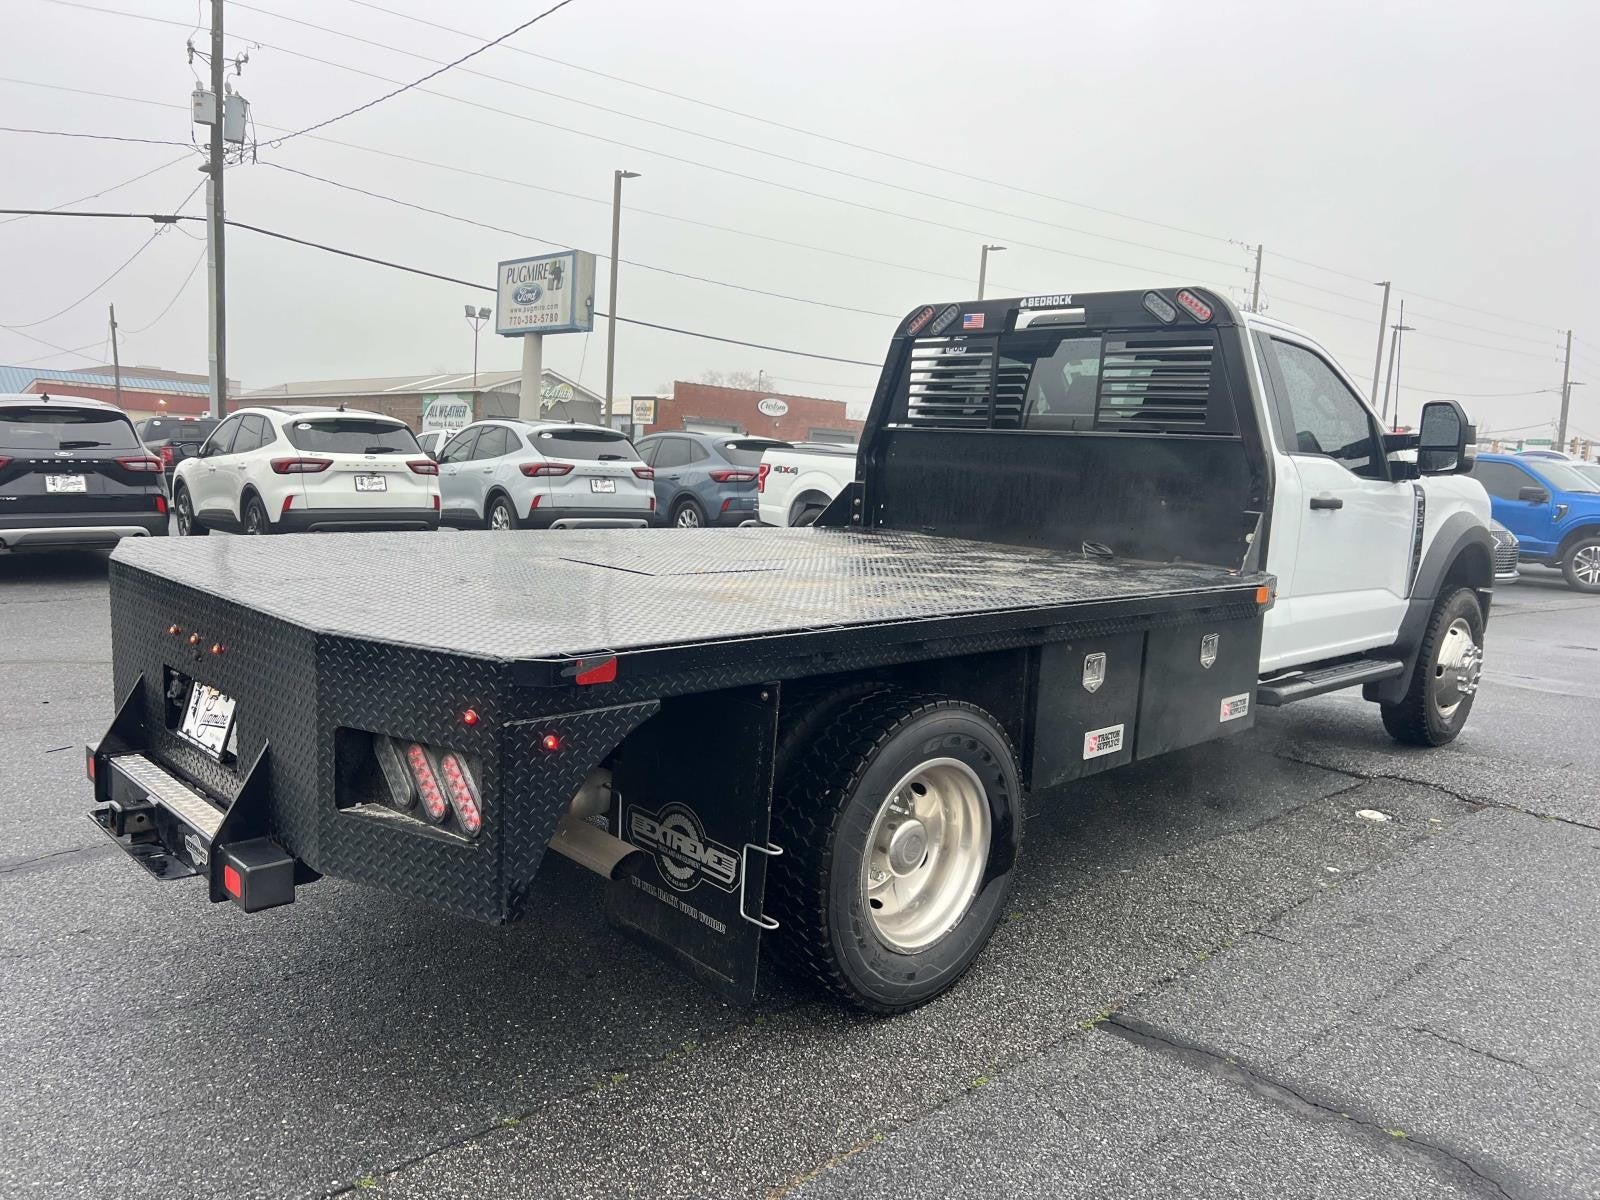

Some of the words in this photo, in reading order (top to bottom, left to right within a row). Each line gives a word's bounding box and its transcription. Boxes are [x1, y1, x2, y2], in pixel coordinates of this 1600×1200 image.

[507, 262, 549, 285] PUGMIRE
[517, 287, 537, 302] Ford
[1028, 295, 1072, 307] BEDROCK
[426, 405, 438, 419] ALL
[438, 405, 467, 418] WEATHER
[1098, 730, 1120, 743] TRACTOR
[1097, 740, 1114, 751] SUPPLY
[631, 811, 737, 874] EXTREME
